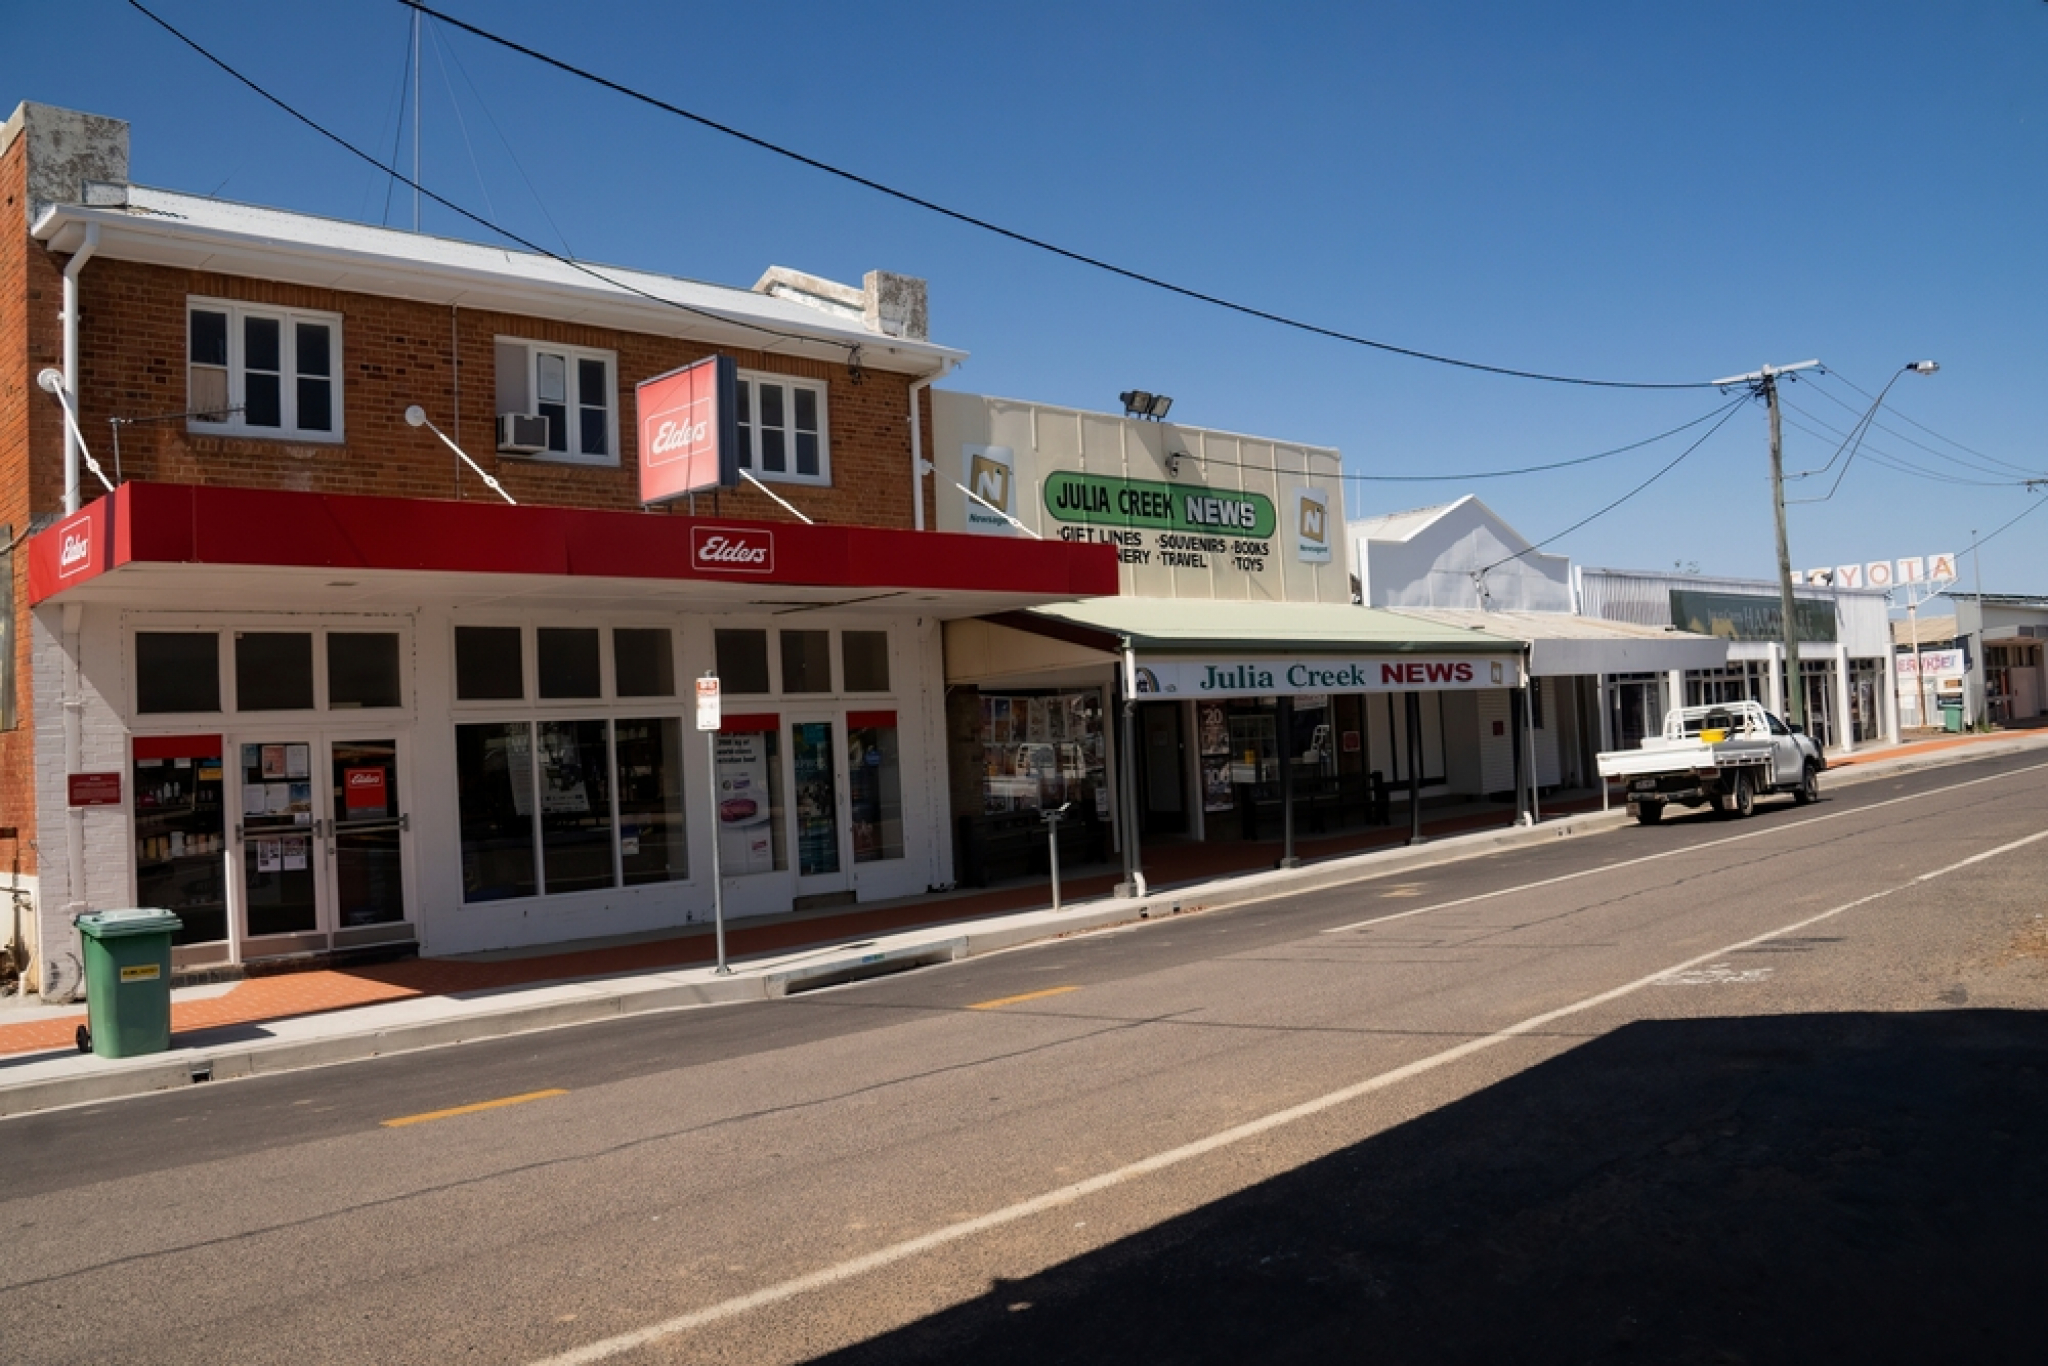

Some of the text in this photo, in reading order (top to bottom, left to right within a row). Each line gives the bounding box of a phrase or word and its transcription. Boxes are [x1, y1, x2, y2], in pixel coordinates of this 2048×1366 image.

[653, 418, 707, 454] Elders
[1057, 483, 1256, 528] JULIA CREEK NEWS
[61, 534, 88, 566] Elders
[699, 536, 766, 563] Elders
[1060, 525, 1269, 555] GIFT LINES SOUVENIRS BOOKS
[1161, 552, 1207, 568] TRAVEL
[1235, 556, 1264, 571] TOYS
[1200, 663, 1474, 690] Julia Creek NEWS
